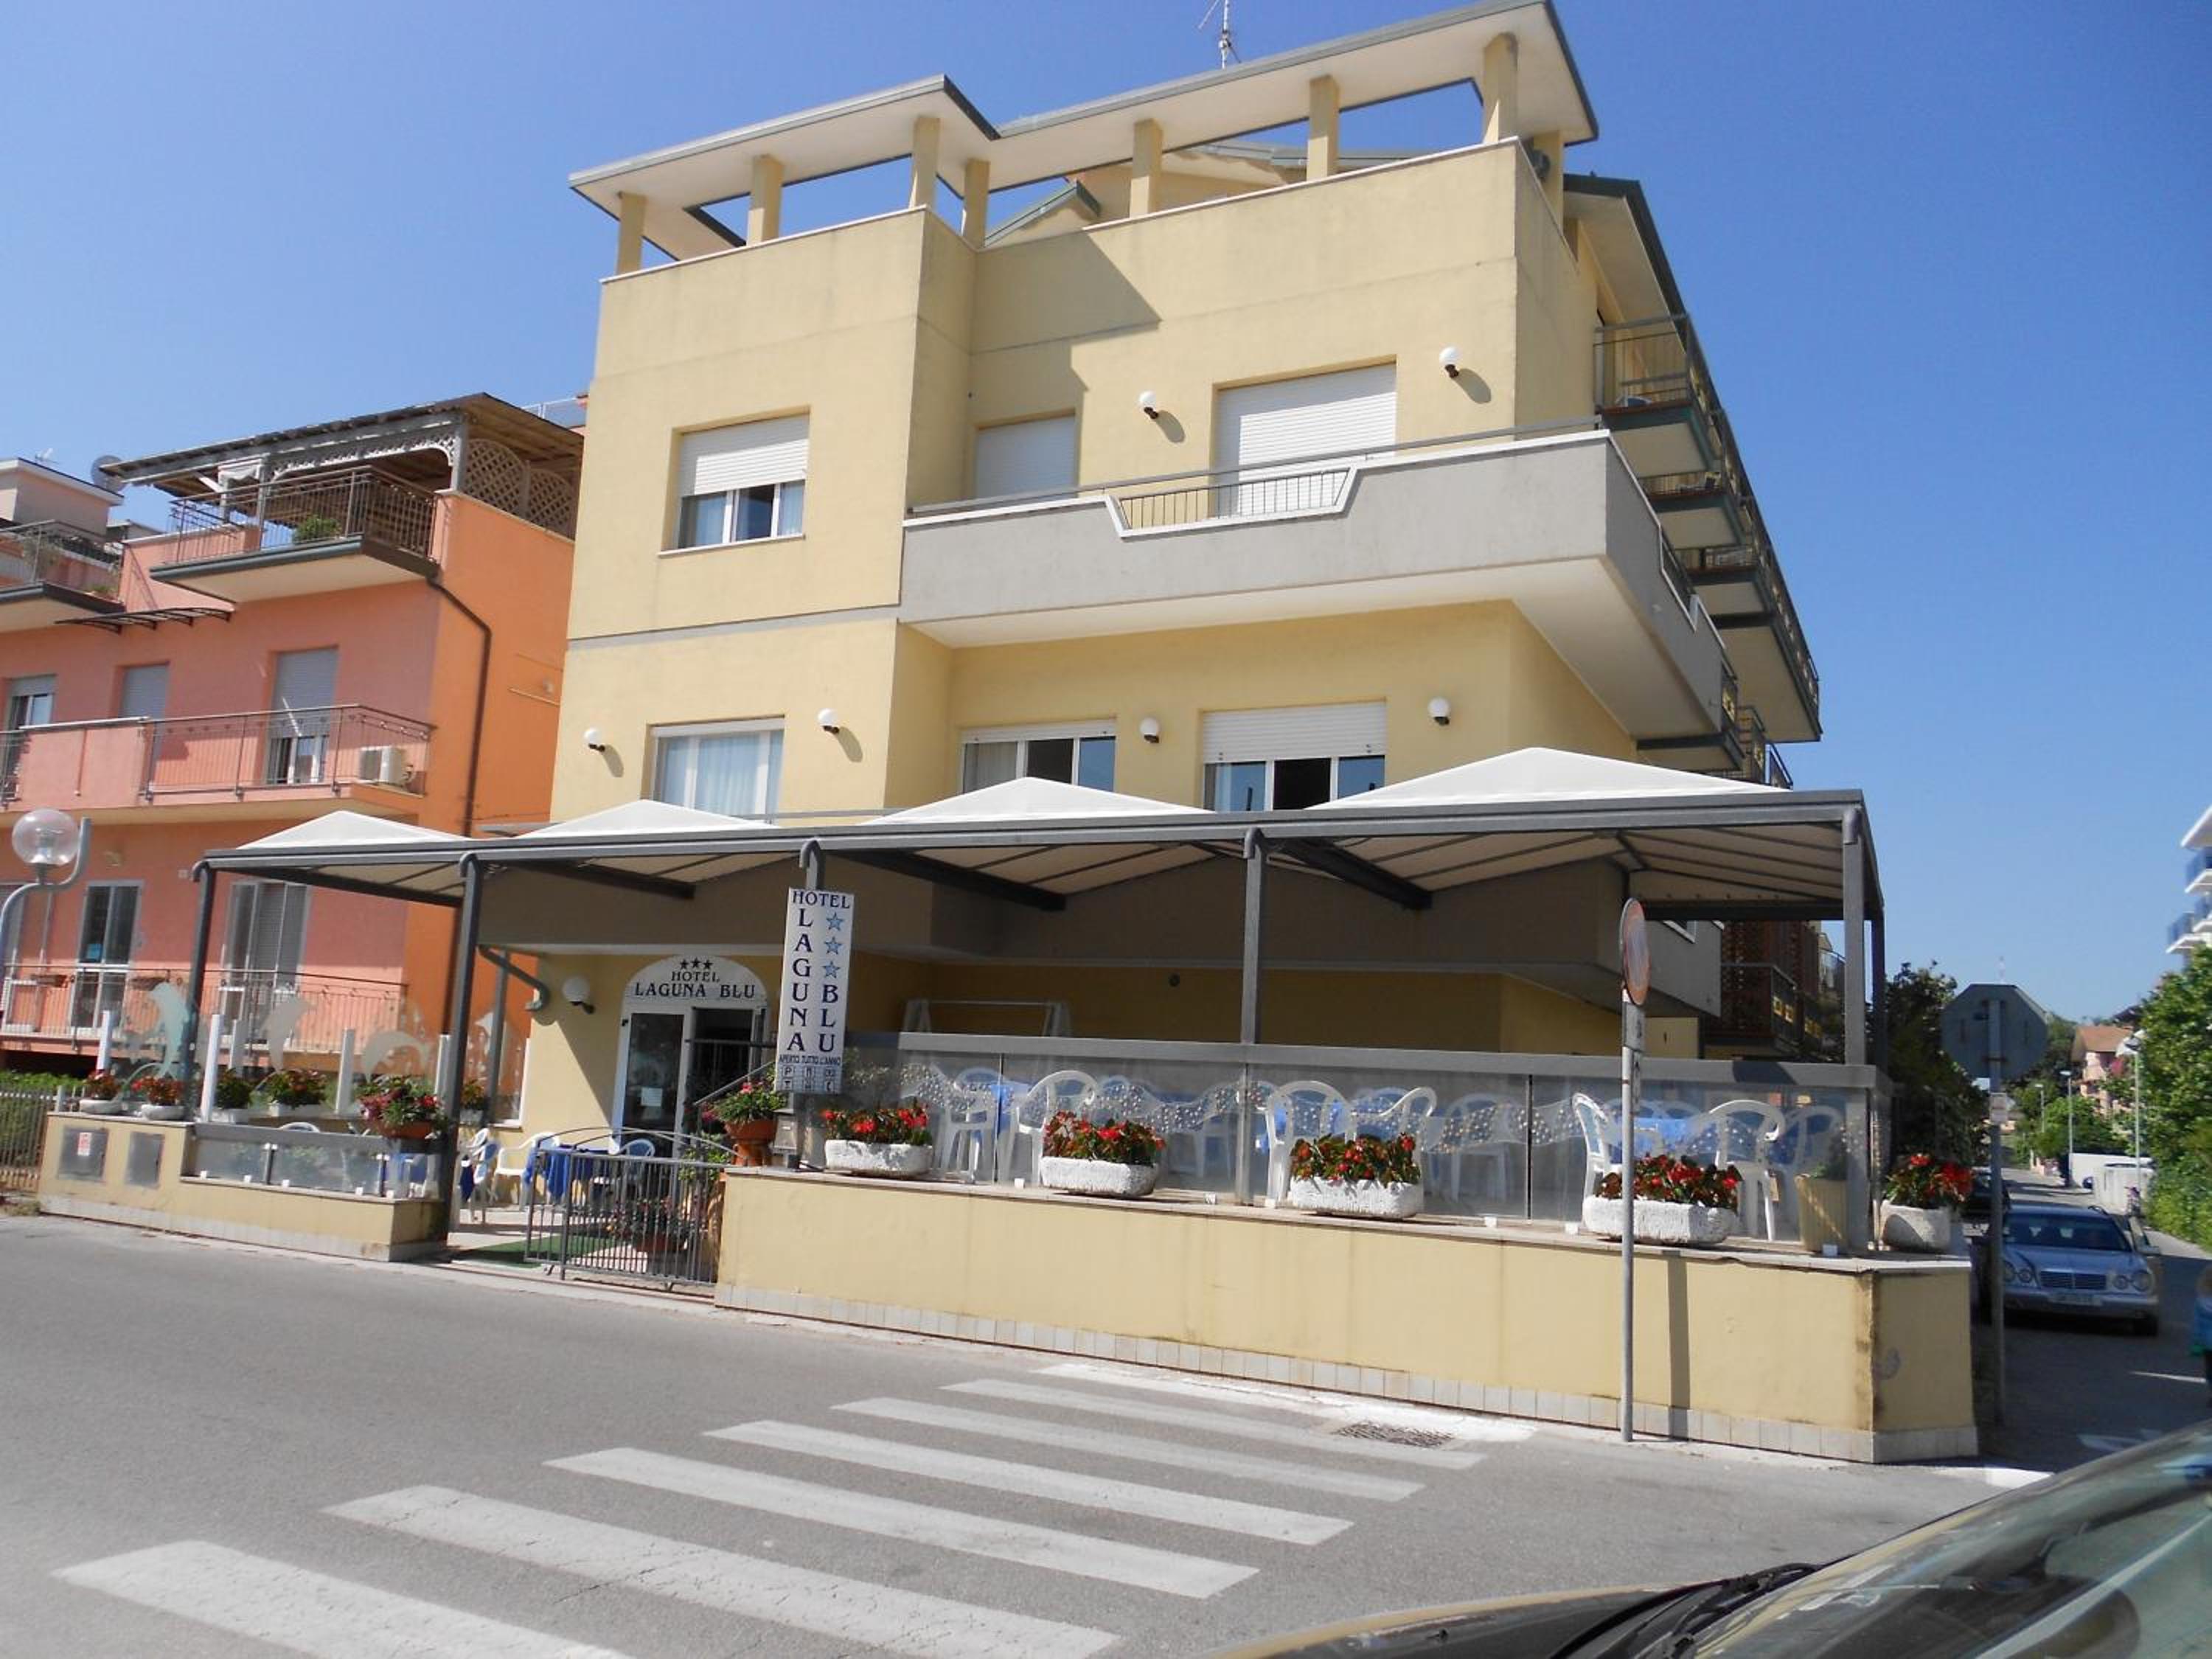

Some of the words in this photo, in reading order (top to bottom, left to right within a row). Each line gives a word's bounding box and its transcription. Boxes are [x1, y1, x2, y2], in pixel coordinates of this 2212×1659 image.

[793, 890, 851, 909] HOTEL
[671, 970, 720, 983] HOTEL
[787, 908, 813, 1052] LAGUNA
[634, 982, 706, 998] LAGUNA
[719, 984, 756, 999] BLU
[818, 984, 839, 1052] BLU
